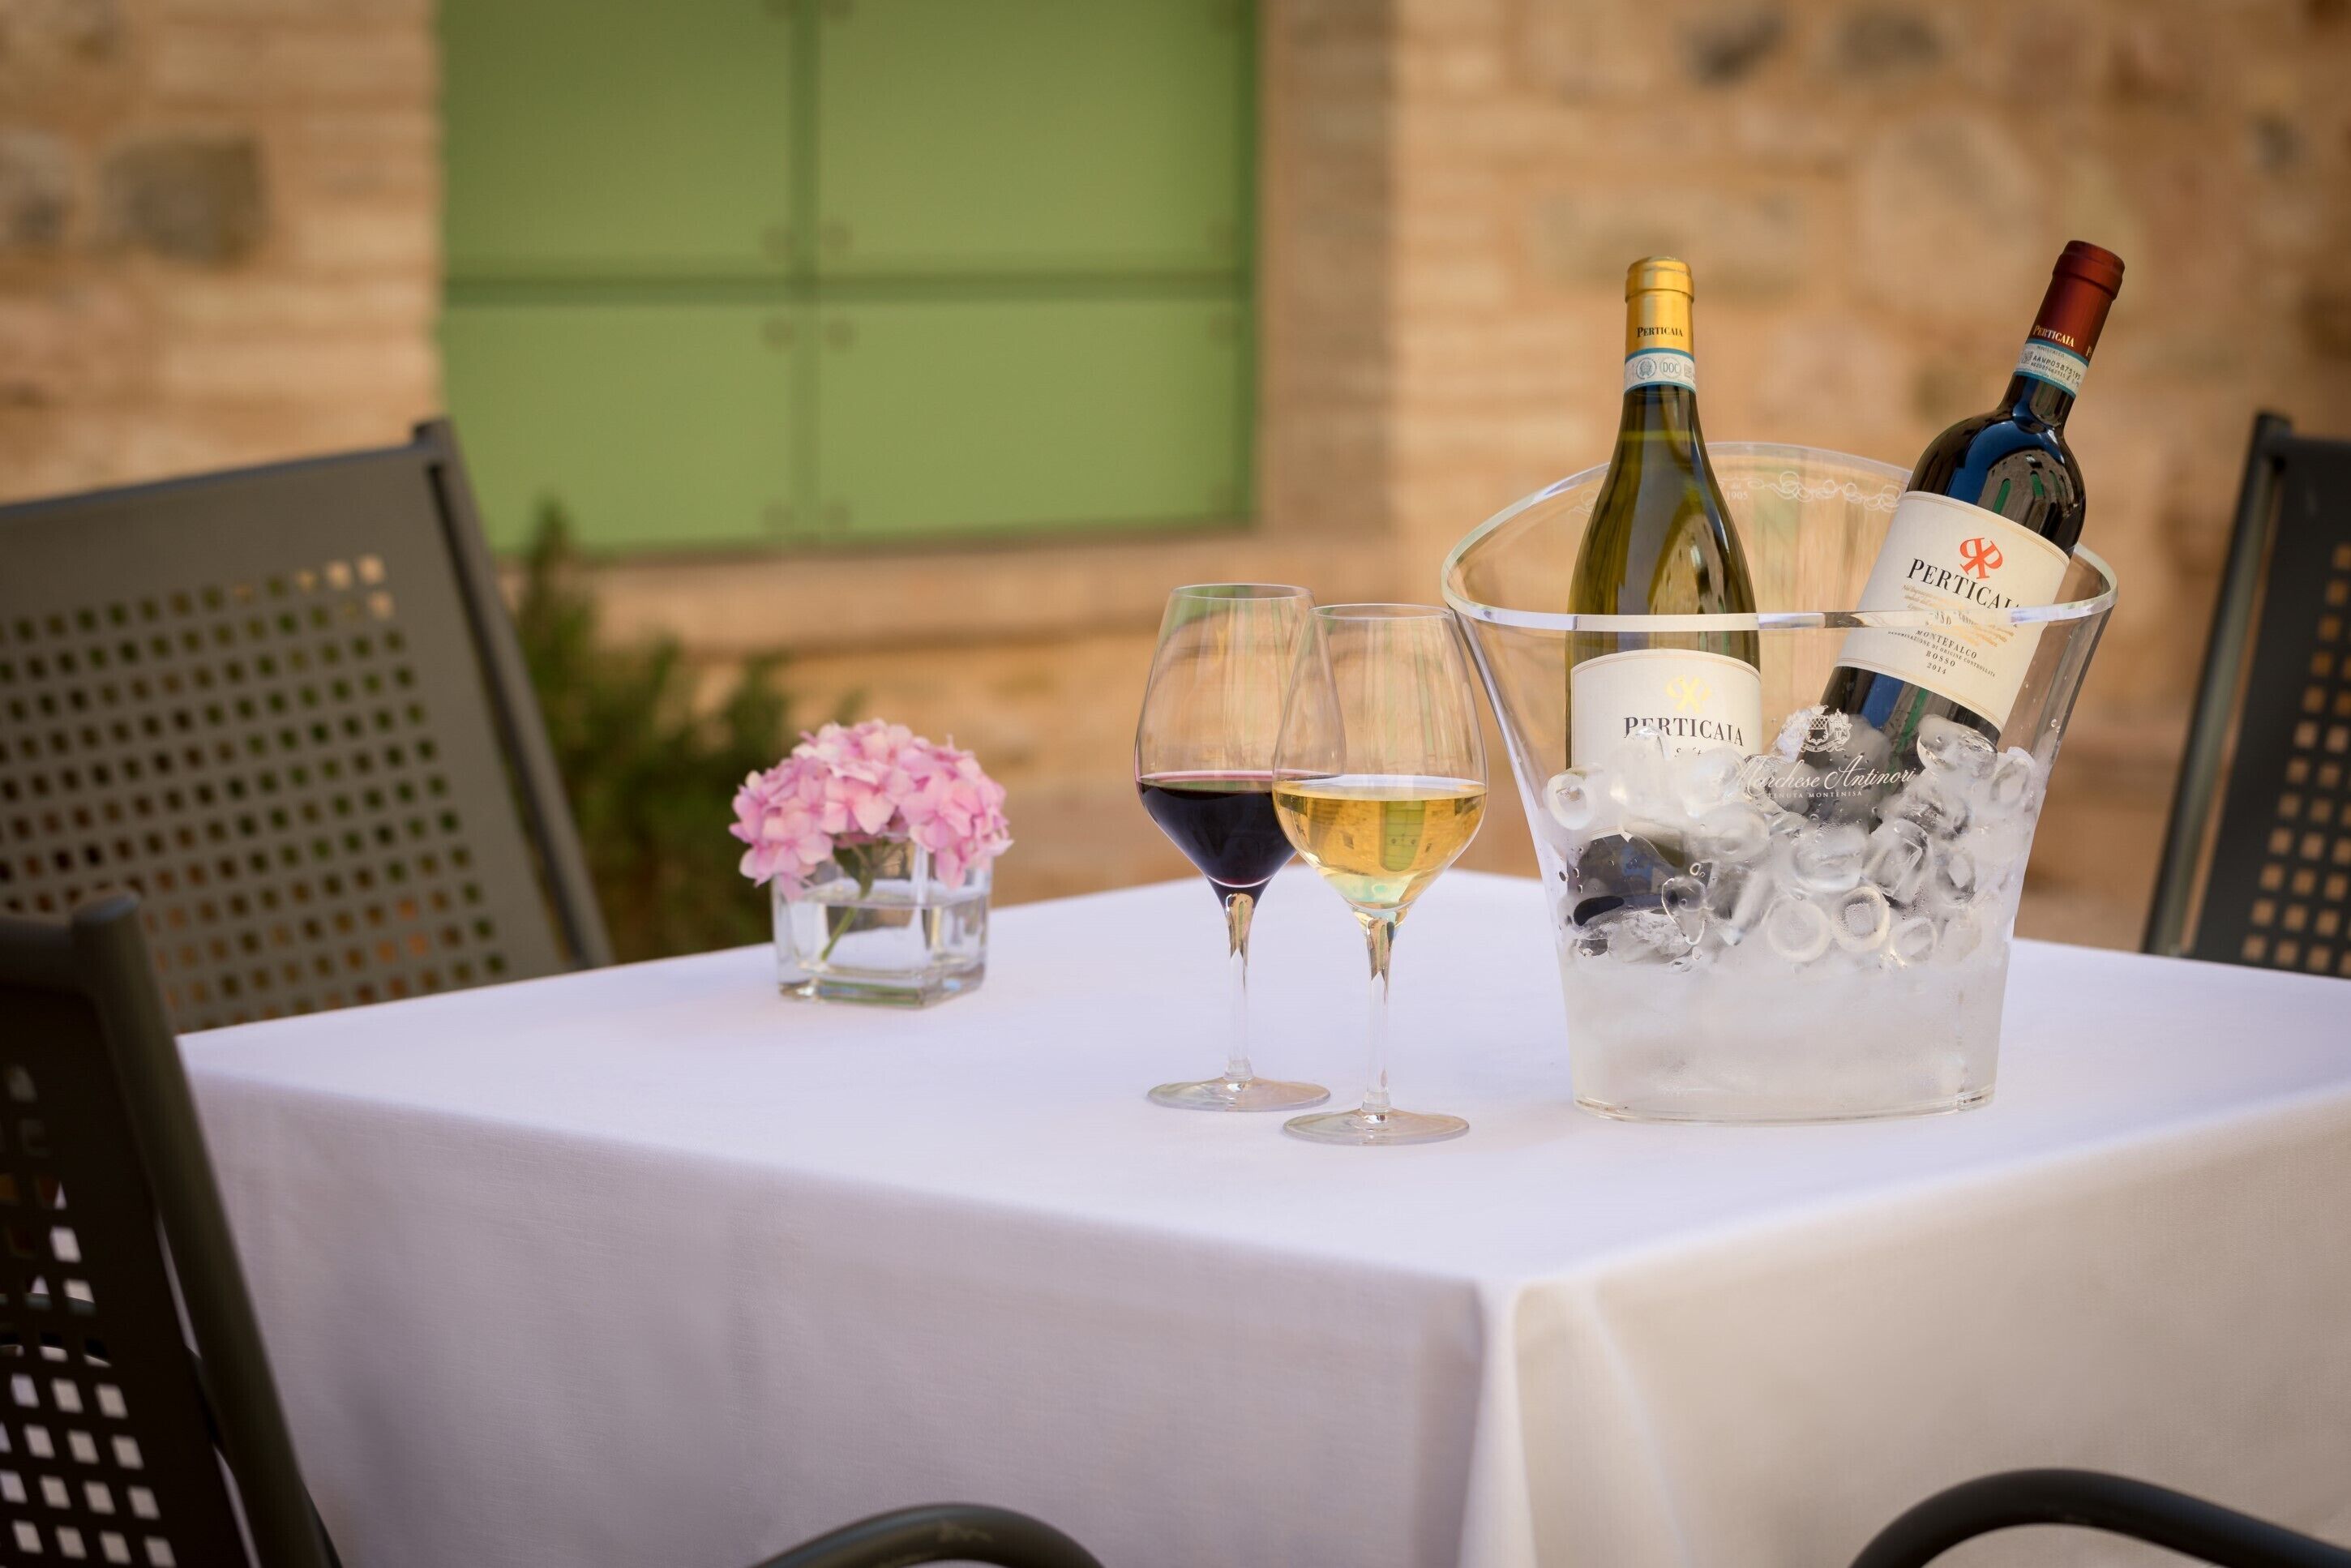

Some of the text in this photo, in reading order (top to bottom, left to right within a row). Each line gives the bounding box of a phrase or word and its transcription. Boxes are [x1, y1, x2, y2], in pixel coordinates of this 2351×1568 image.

[1637, 326, 1684, 338] PERTICAIA
[2032, 326, 2075, 347] PERTICAIA
[1663, 362, 1680, 374] DOC
[1906, 558, 2020, 610] PERTICAI
[1915, 630, 1977, 659] MONTEFALCO
[1925, 650, 1956, 667] ROSSO
[1939, 647, 1963, 660] ORIGINE
[1926, 662, 1946, 675] 2014
[1823, 754, 1916, 790] Antinori
[1808, 790, 1863, 799] MONTENISA
